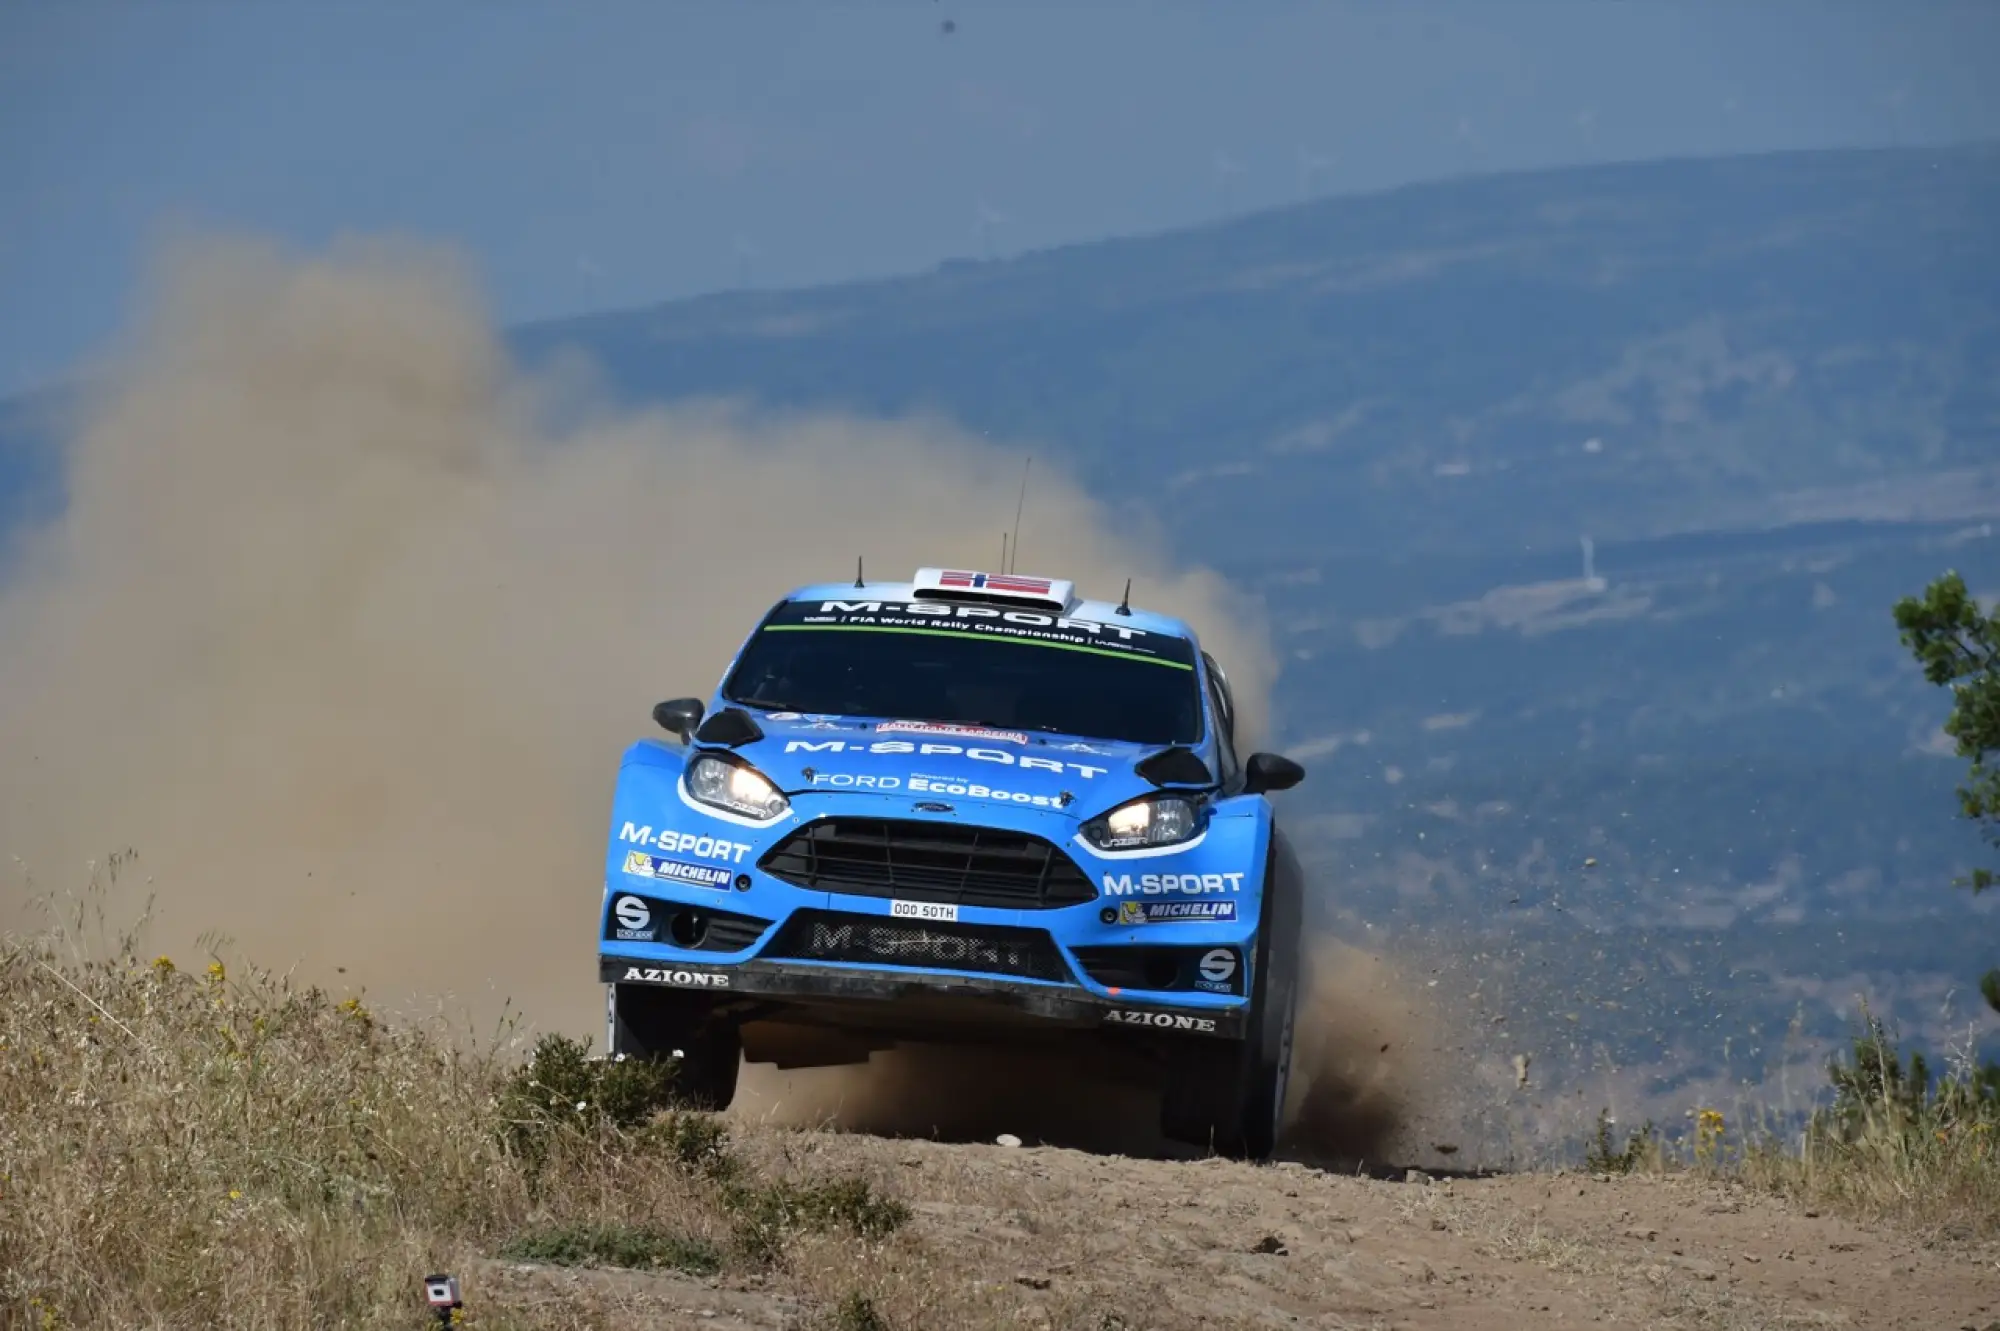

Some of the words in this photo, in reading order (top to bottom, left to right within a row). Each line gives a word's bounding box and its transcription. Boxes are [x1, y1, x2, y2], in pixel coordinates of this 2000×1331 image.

[820, 601, 1147, 639] M-SPORT
[880, 617, 926, 626] World
[931, 619, 970, 630] Rally
[974, 624, 1085, 643] Championship
[784, 741, 1109, 779] M-SPORT
[812, 774, 901, 788] FORD
[908, 777, 1063, 809] EcoBoost
[619, 821, 752, 863] M-SPORT
[658, 861, 731, 884] MICHELIN
[1103, 872, 1244, 896] M-SPORT
[1150, 903, 1233, 917] MICHELIN
[624, 967, 729, 986] AZIONE
[1103, 1010, 1217, 1032] AZIONE
